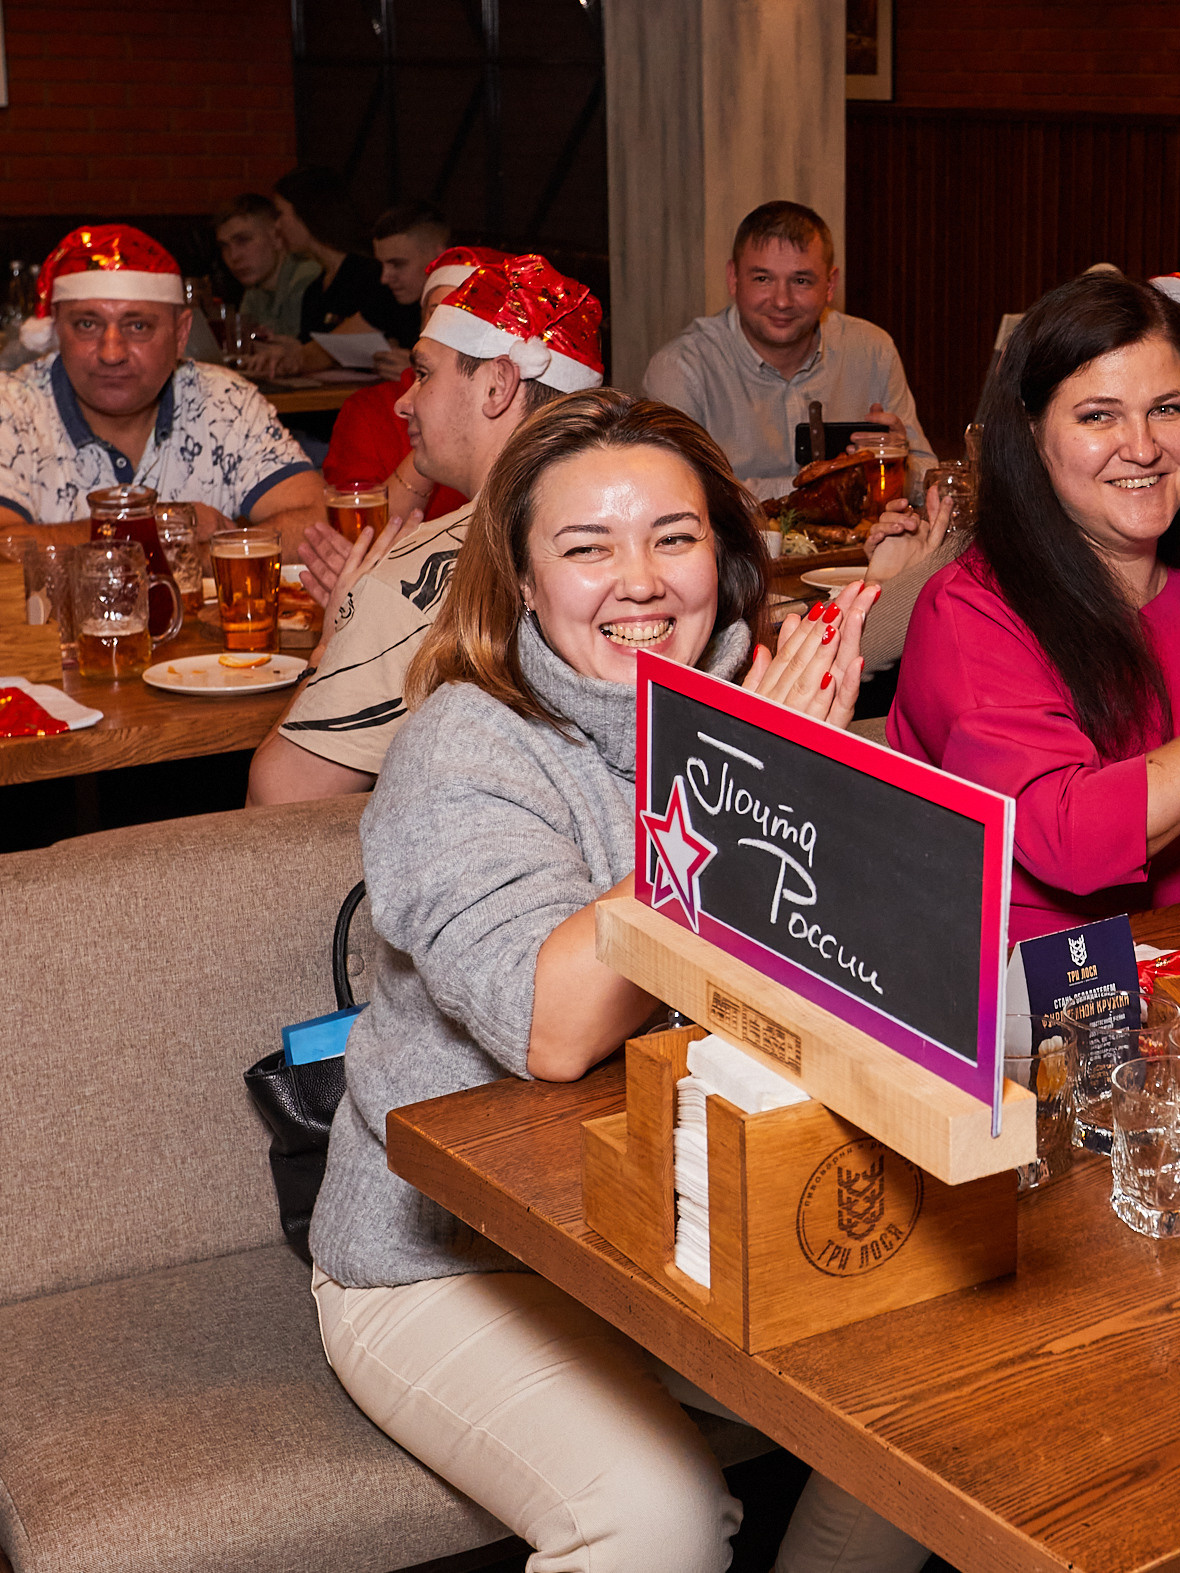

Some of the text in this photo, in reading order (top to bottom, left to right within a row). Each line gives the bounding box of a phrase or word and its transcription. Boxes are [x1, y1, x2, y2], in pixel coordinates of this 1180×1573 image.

[737, 837, 884, 995] России
[1066, 970, 1080, 984] ТРИ
[1081, 964, 1098, 980] ЛОСЯ
[816, 1223, 904, 1271] ТРИ ЛОСЯ
